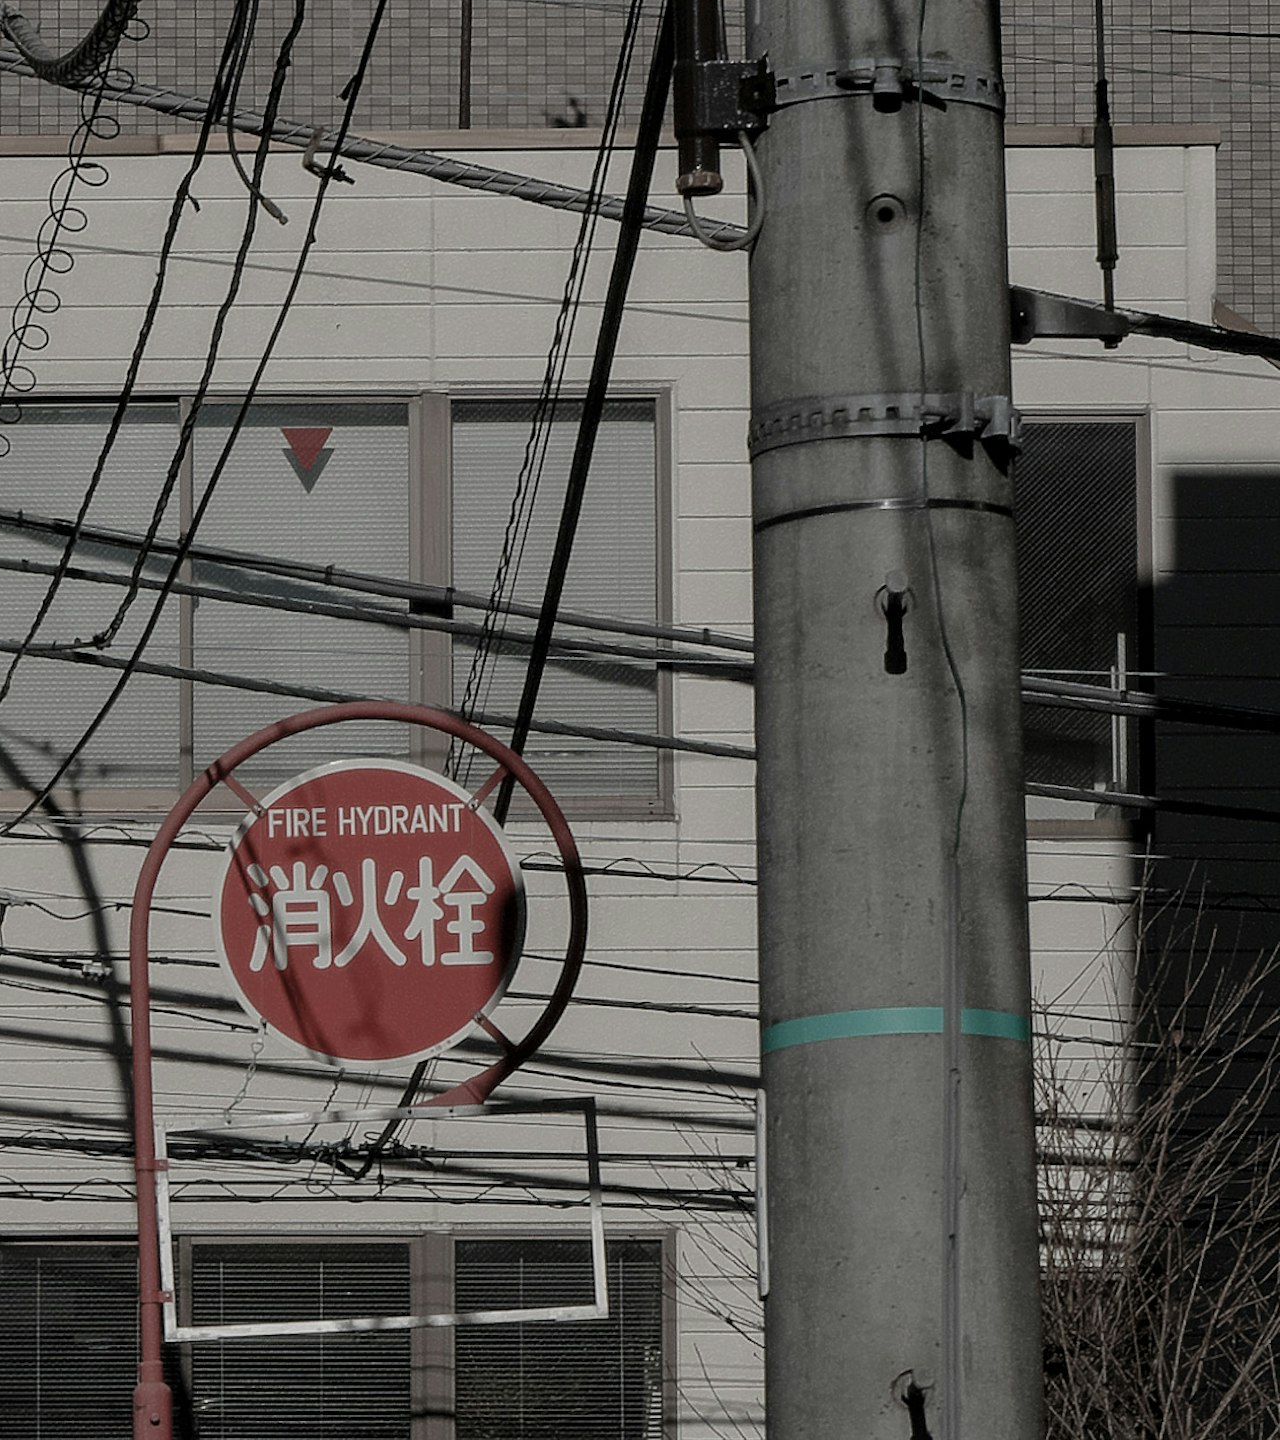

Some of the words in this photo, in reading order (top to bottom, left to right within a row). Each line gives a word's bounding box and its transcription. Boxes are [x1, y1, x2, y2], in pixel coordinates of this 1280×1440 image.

[267, 806, 328, 839] FIRE
[338, 803, 466, 837] HYDRANT
[246, 852, 497, 974] 消火栓
